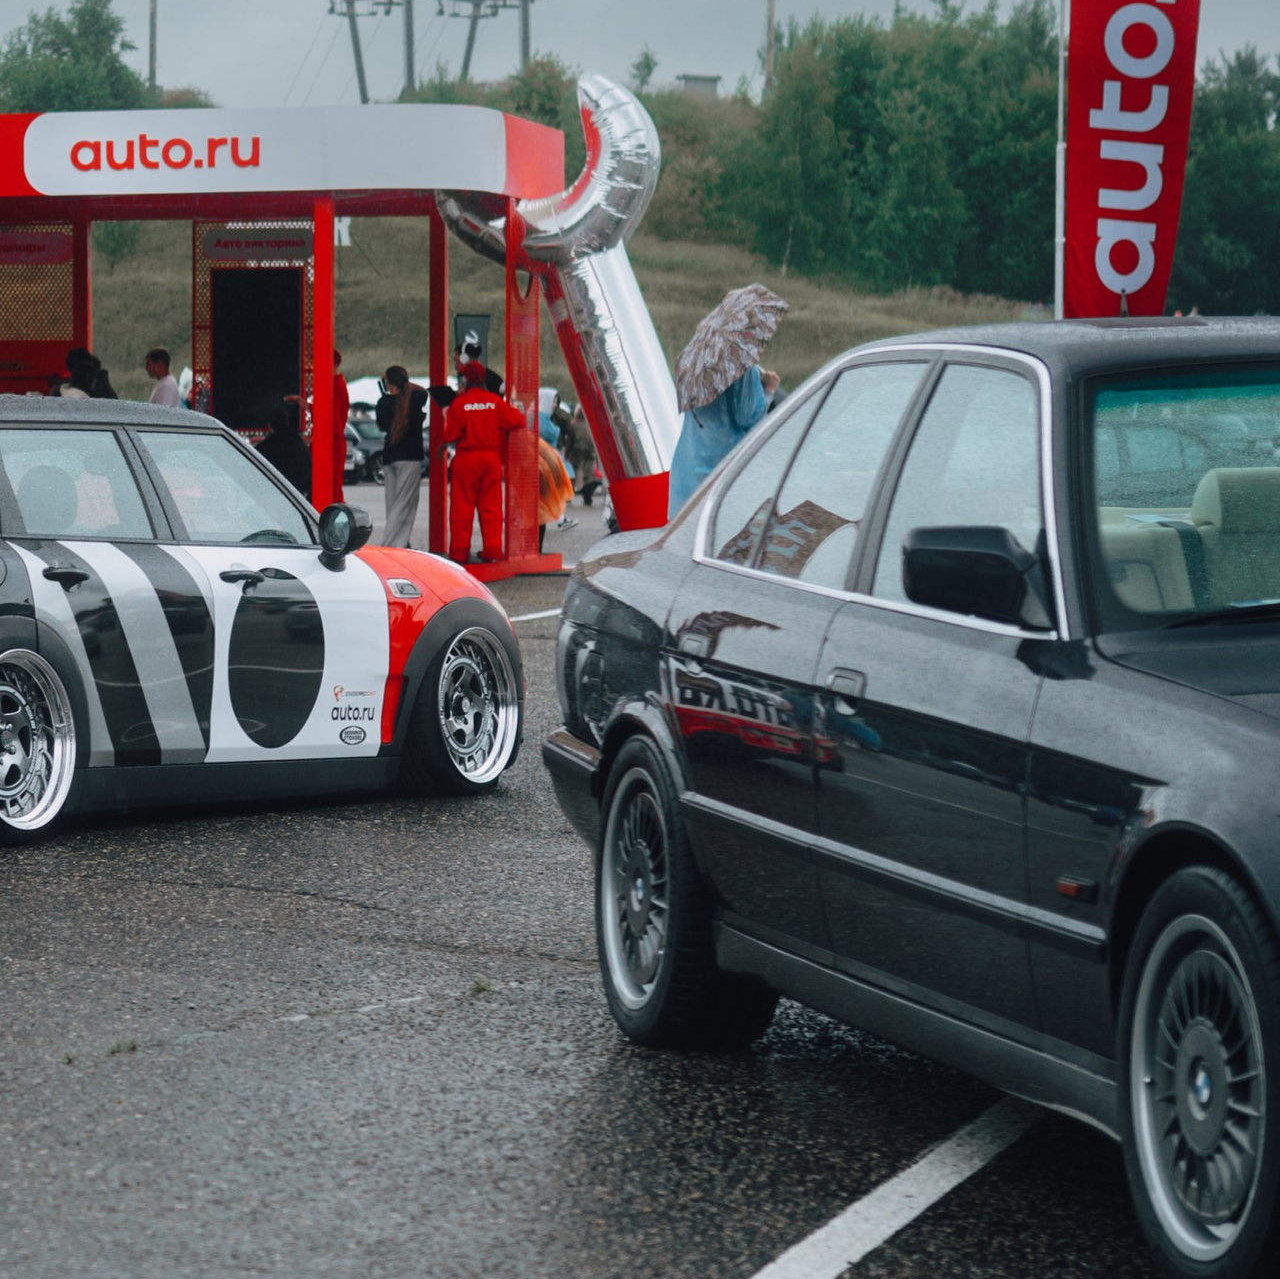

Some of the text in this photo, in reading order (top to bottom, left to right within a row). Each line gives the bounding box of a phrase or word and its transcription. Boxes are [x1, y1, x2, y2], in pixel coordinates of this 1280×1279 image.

[70, 133, 260, 172] auto.ru
[214, 238, 242, 248] Авто
[464, 402, 495, 411] auto.ru
[331, 704, 375, 721] auto.ru
